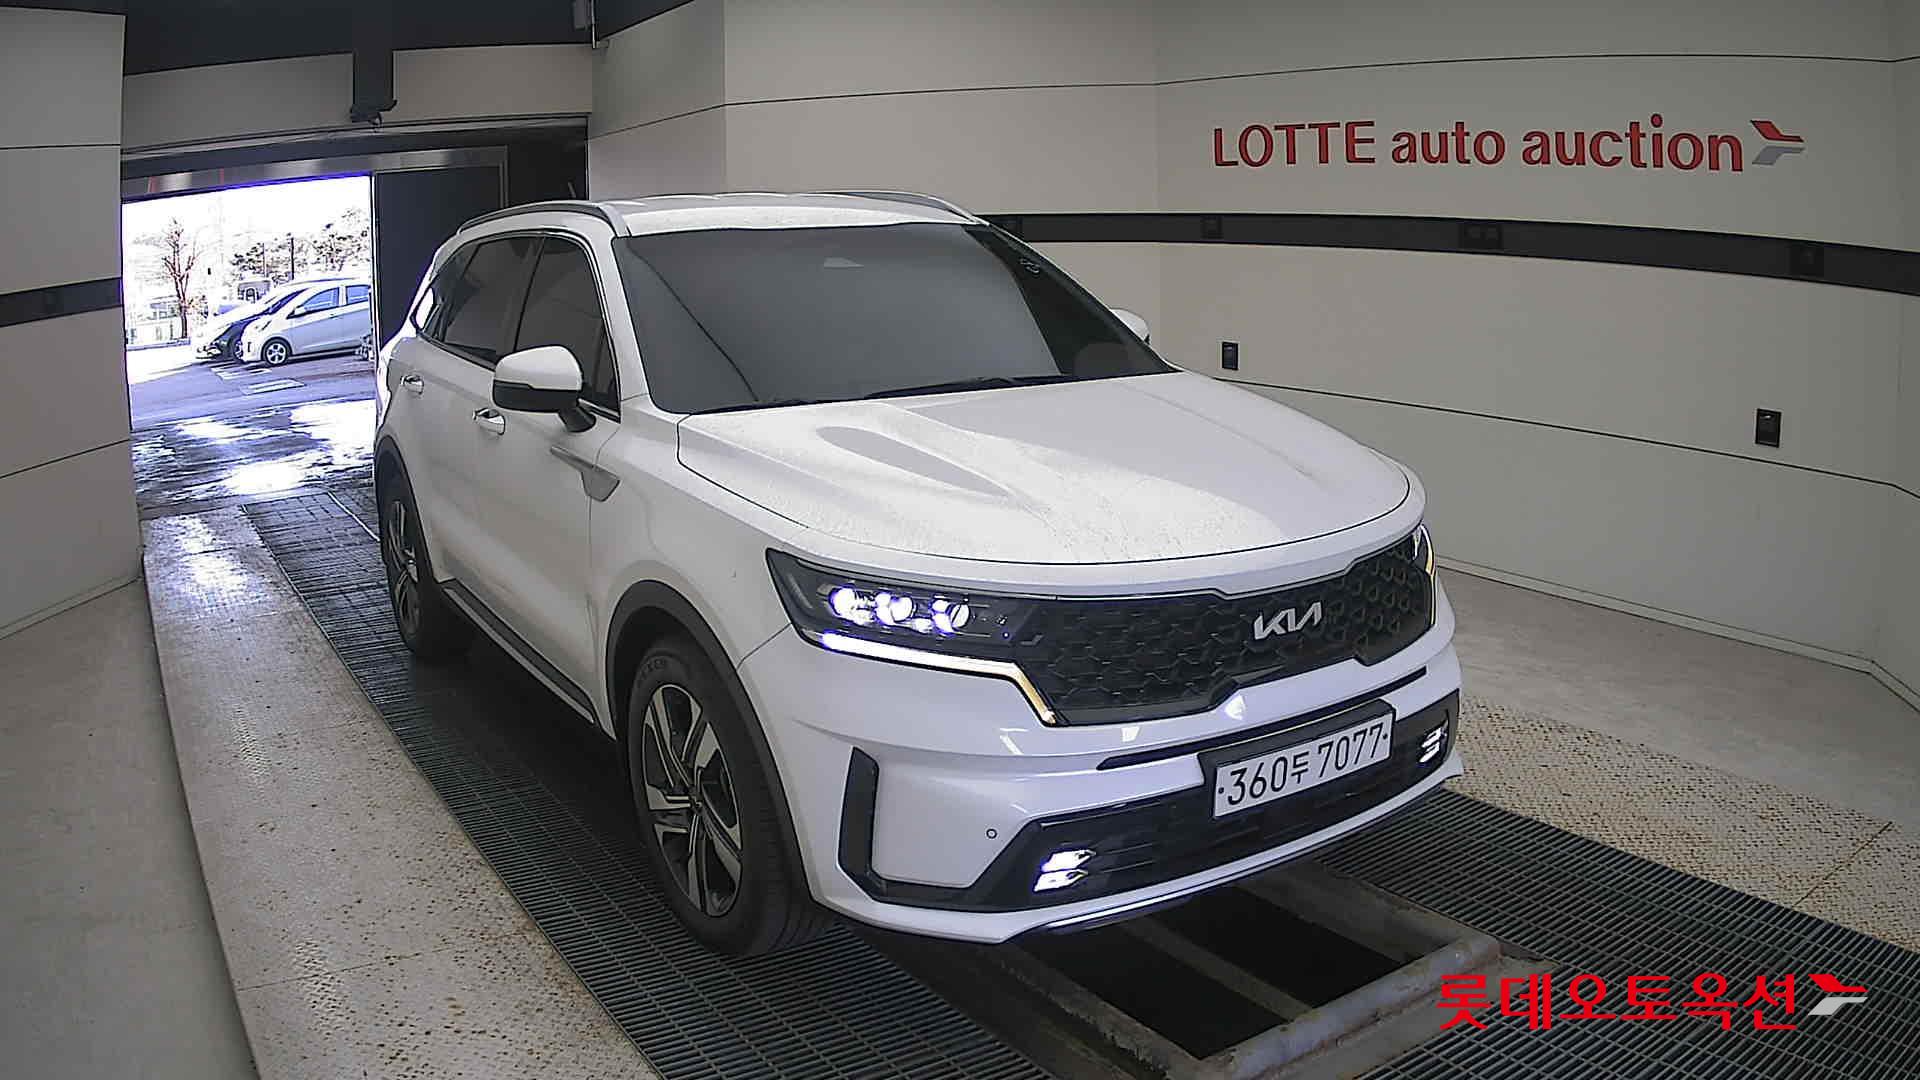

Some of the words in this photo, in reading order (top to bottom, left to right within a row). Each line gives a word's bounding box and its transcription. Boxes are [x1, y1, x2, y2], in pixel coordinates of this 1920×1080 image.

[1213, 121, 1376, 167] LOTTE
[1391, 121, 1506, 166] auto
[1521, 113, 1744, 172] auction
[1253, 600, 1322, 640] KIA
[1317, 722, 1384, 778] 7077
